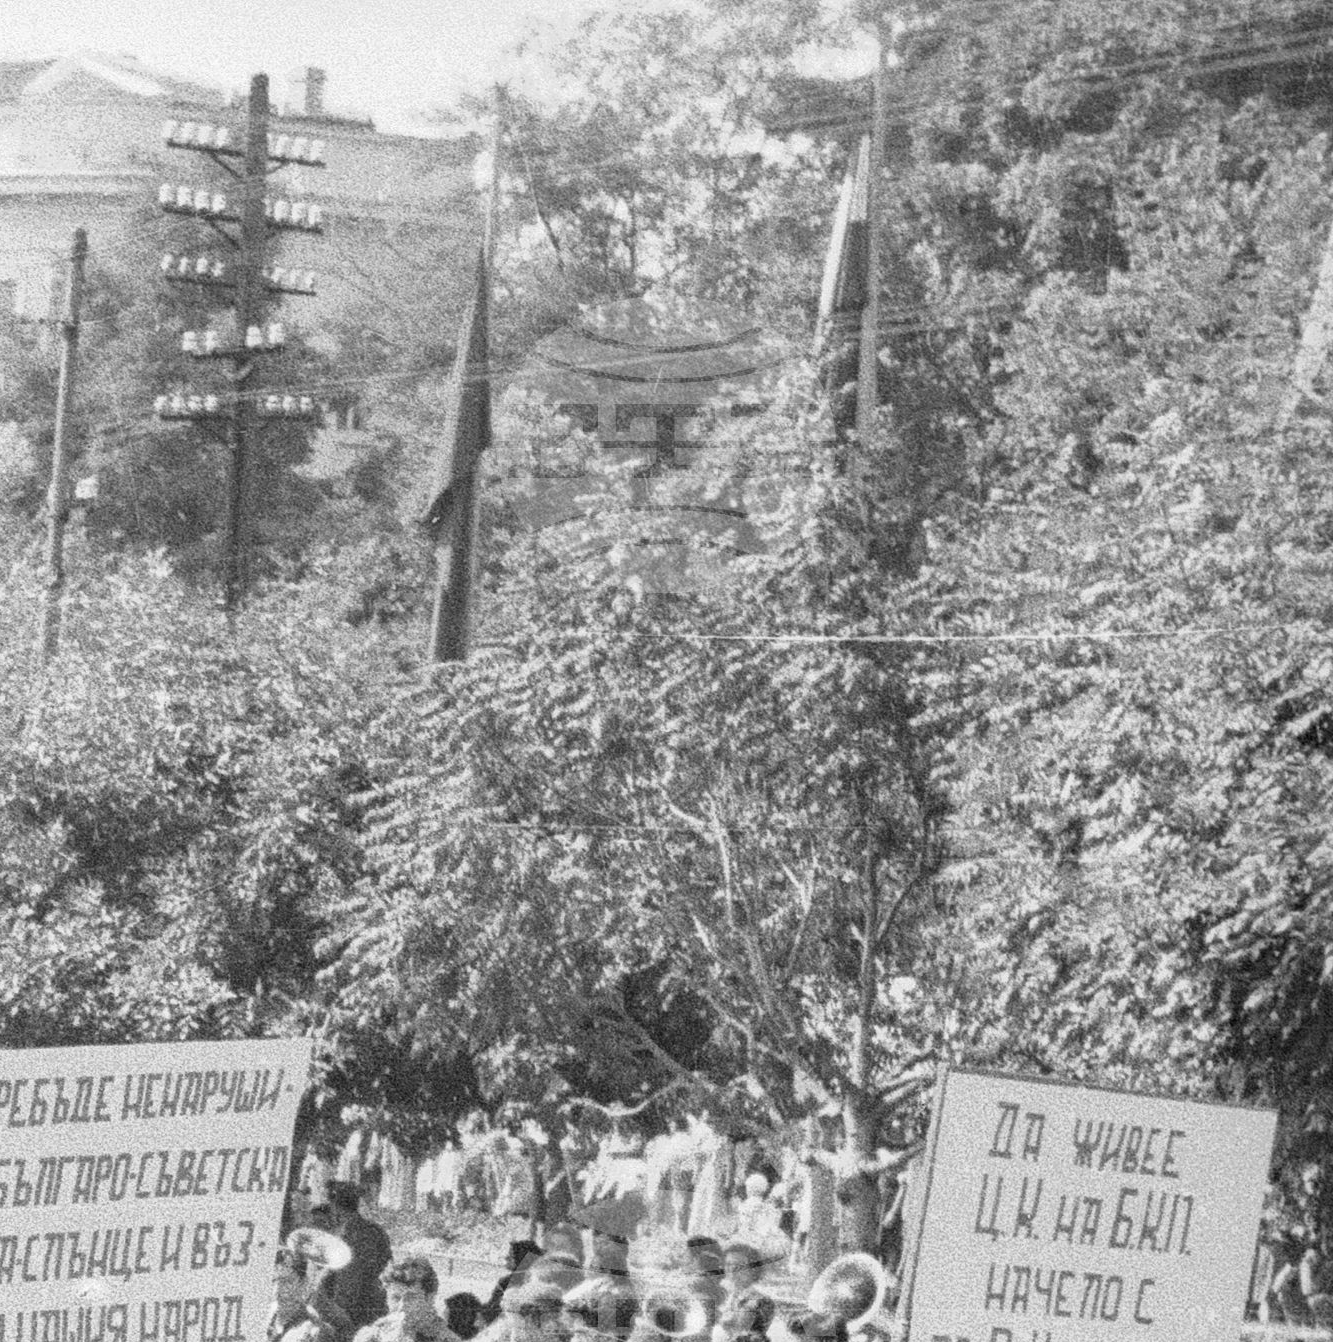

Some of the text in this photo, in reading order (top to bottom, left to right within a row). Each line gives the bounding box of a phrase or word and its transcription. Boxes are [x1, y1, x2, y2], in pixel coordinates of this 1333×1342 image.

[988, 1101, 1186, 1179] ДА ЖИВЕЕ
[160, 1225, 185, 1272] И
[1053, 1194, 1103, 1246] НА
[985, 1262, 1155, 1325] НАЧЕЛО С
